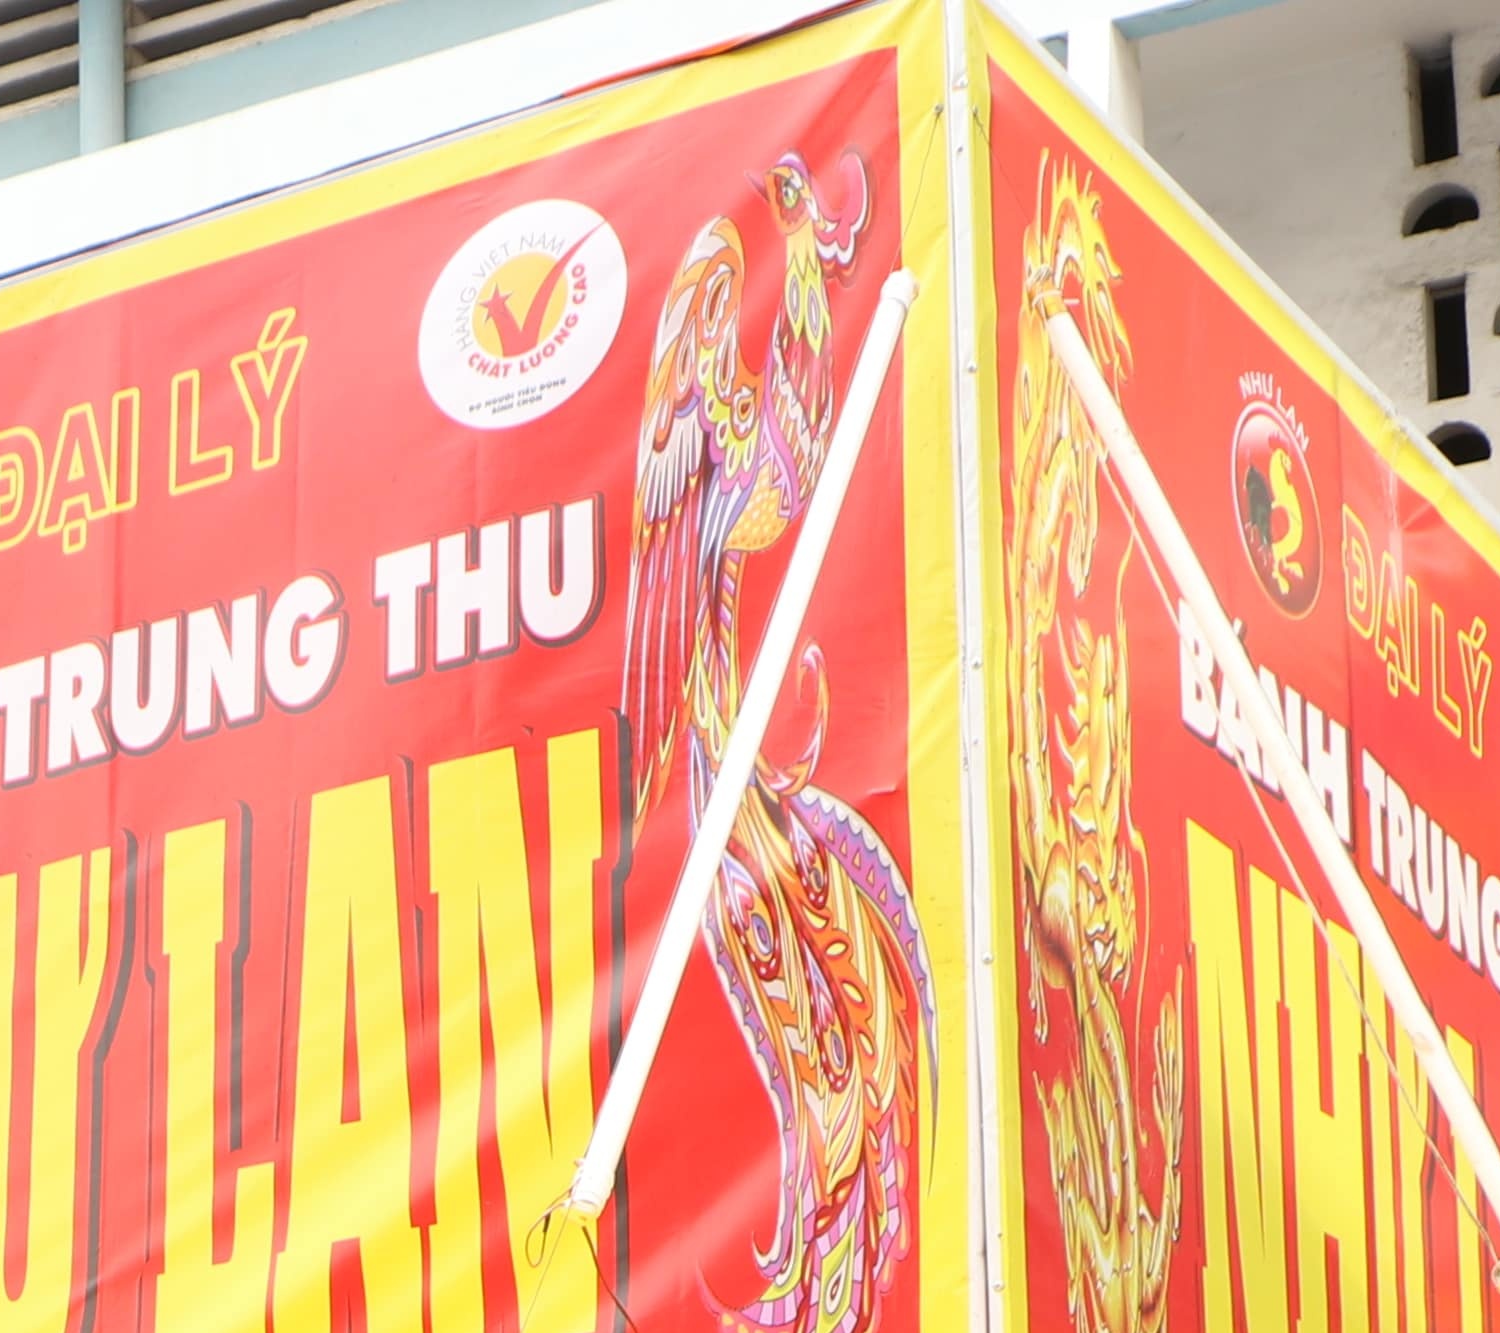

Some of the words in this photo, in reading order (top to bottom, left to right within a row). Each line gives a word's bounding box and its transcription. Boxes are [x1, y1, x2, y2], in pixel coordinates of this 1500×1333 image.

[170, 306, 307, 498] LÝ
[373, 498, 604, 685] THU
[1342, 503, 1421, 698] ĐẠI
[1432, 615, 1492, 758] LÝ
